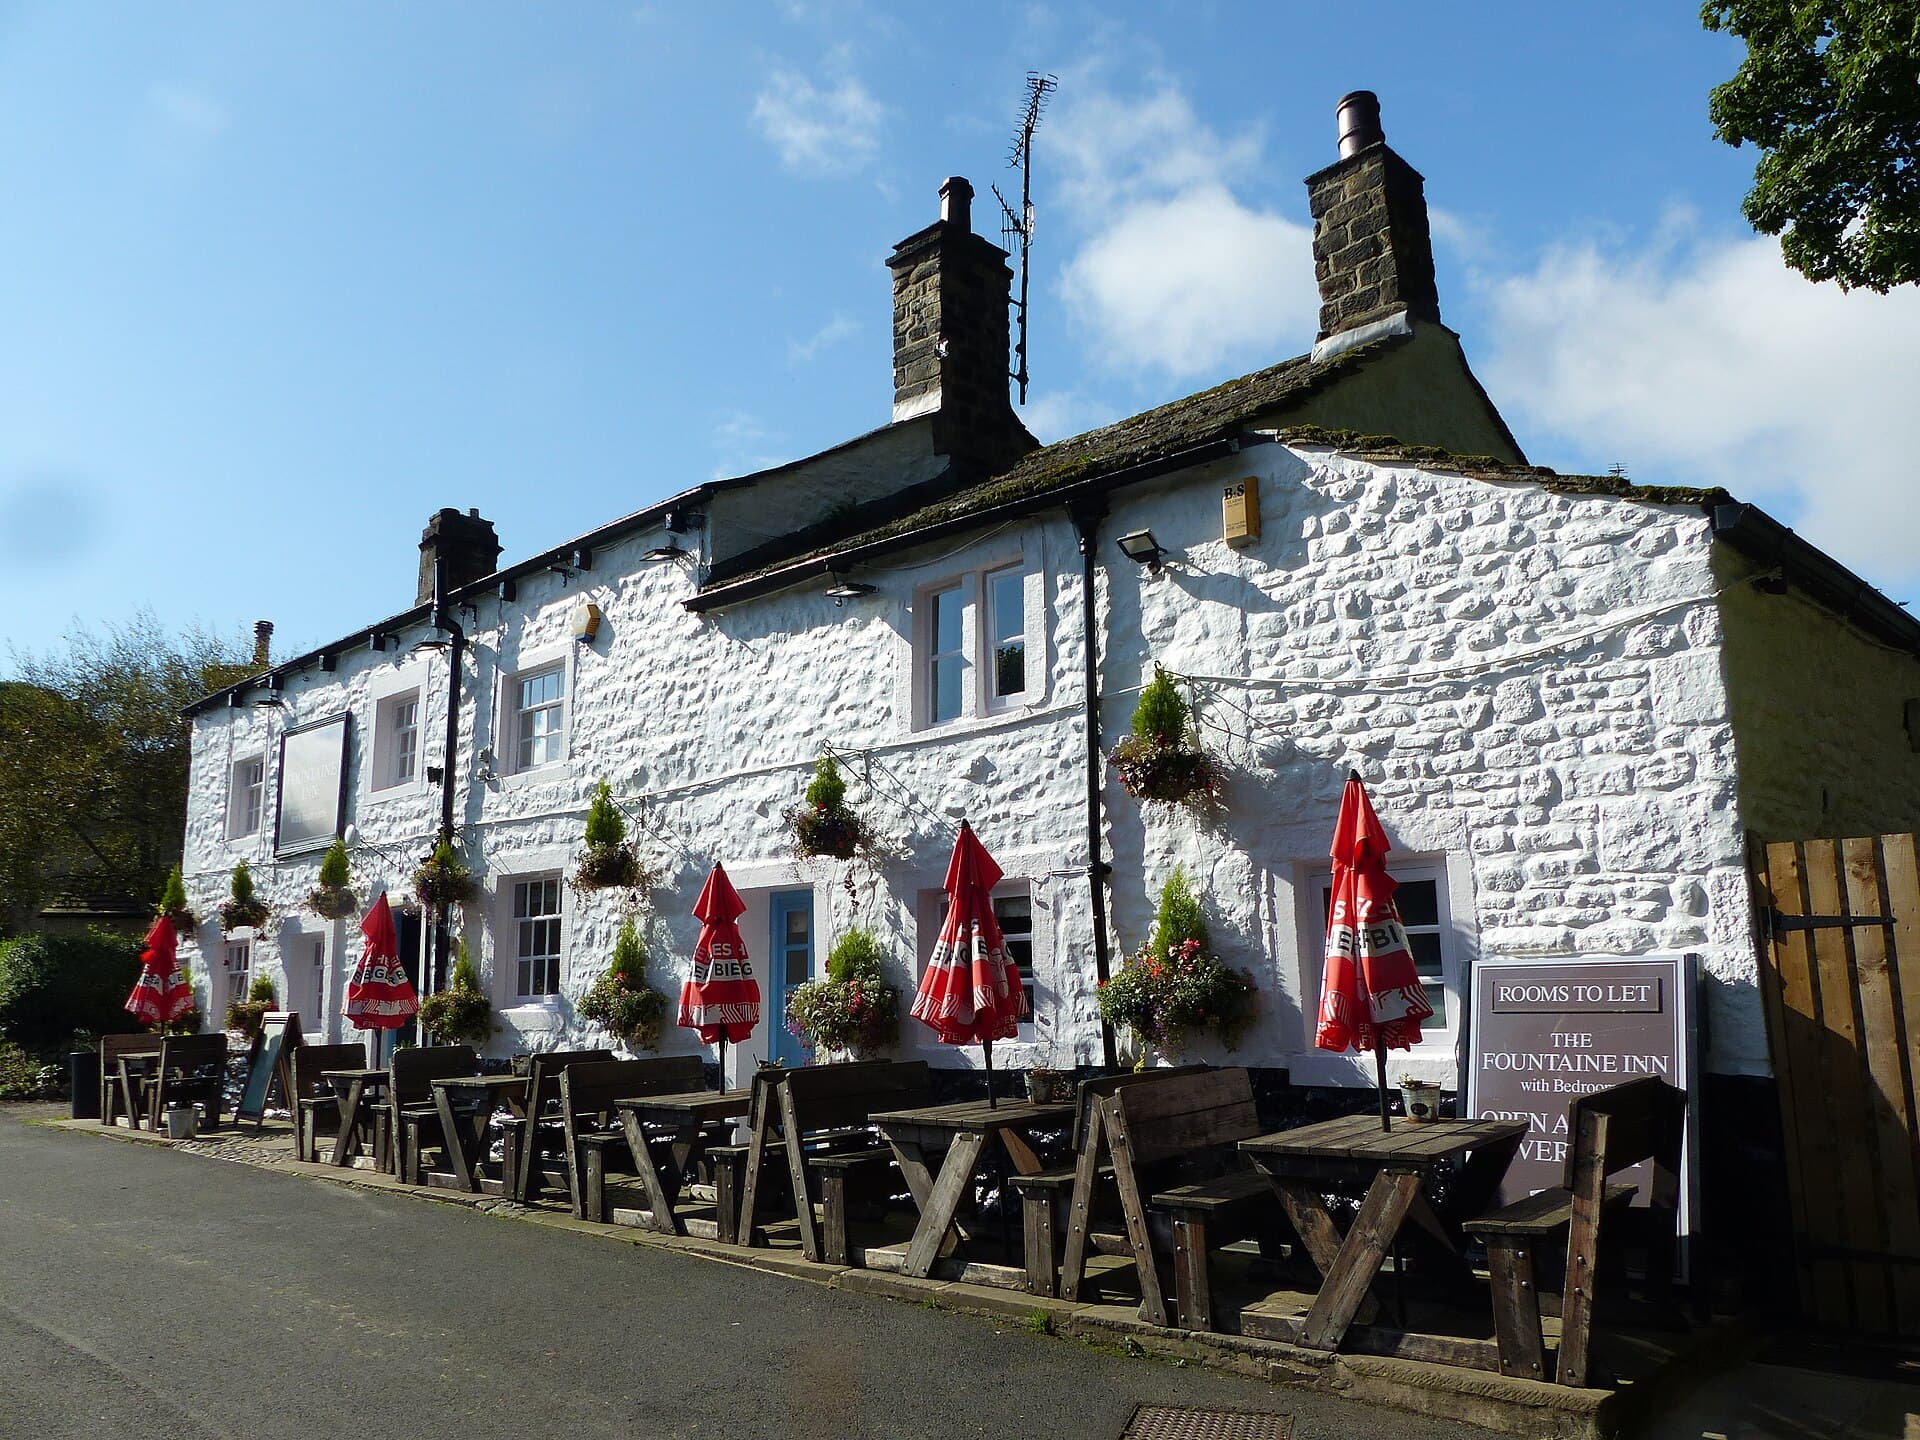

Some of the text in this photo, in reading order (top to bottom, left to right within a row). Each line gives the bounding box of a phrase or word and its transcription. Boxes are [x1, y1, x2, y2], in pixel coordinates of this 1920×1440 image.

[1498, 984, 1650, 1003] ROOMS TO LET
[1550, 1032, 1592, 1049] THE
[1481, 1053, 1669, 1075] FOUNTAINE INN
[1520, 1078, 1550, 1092] with
